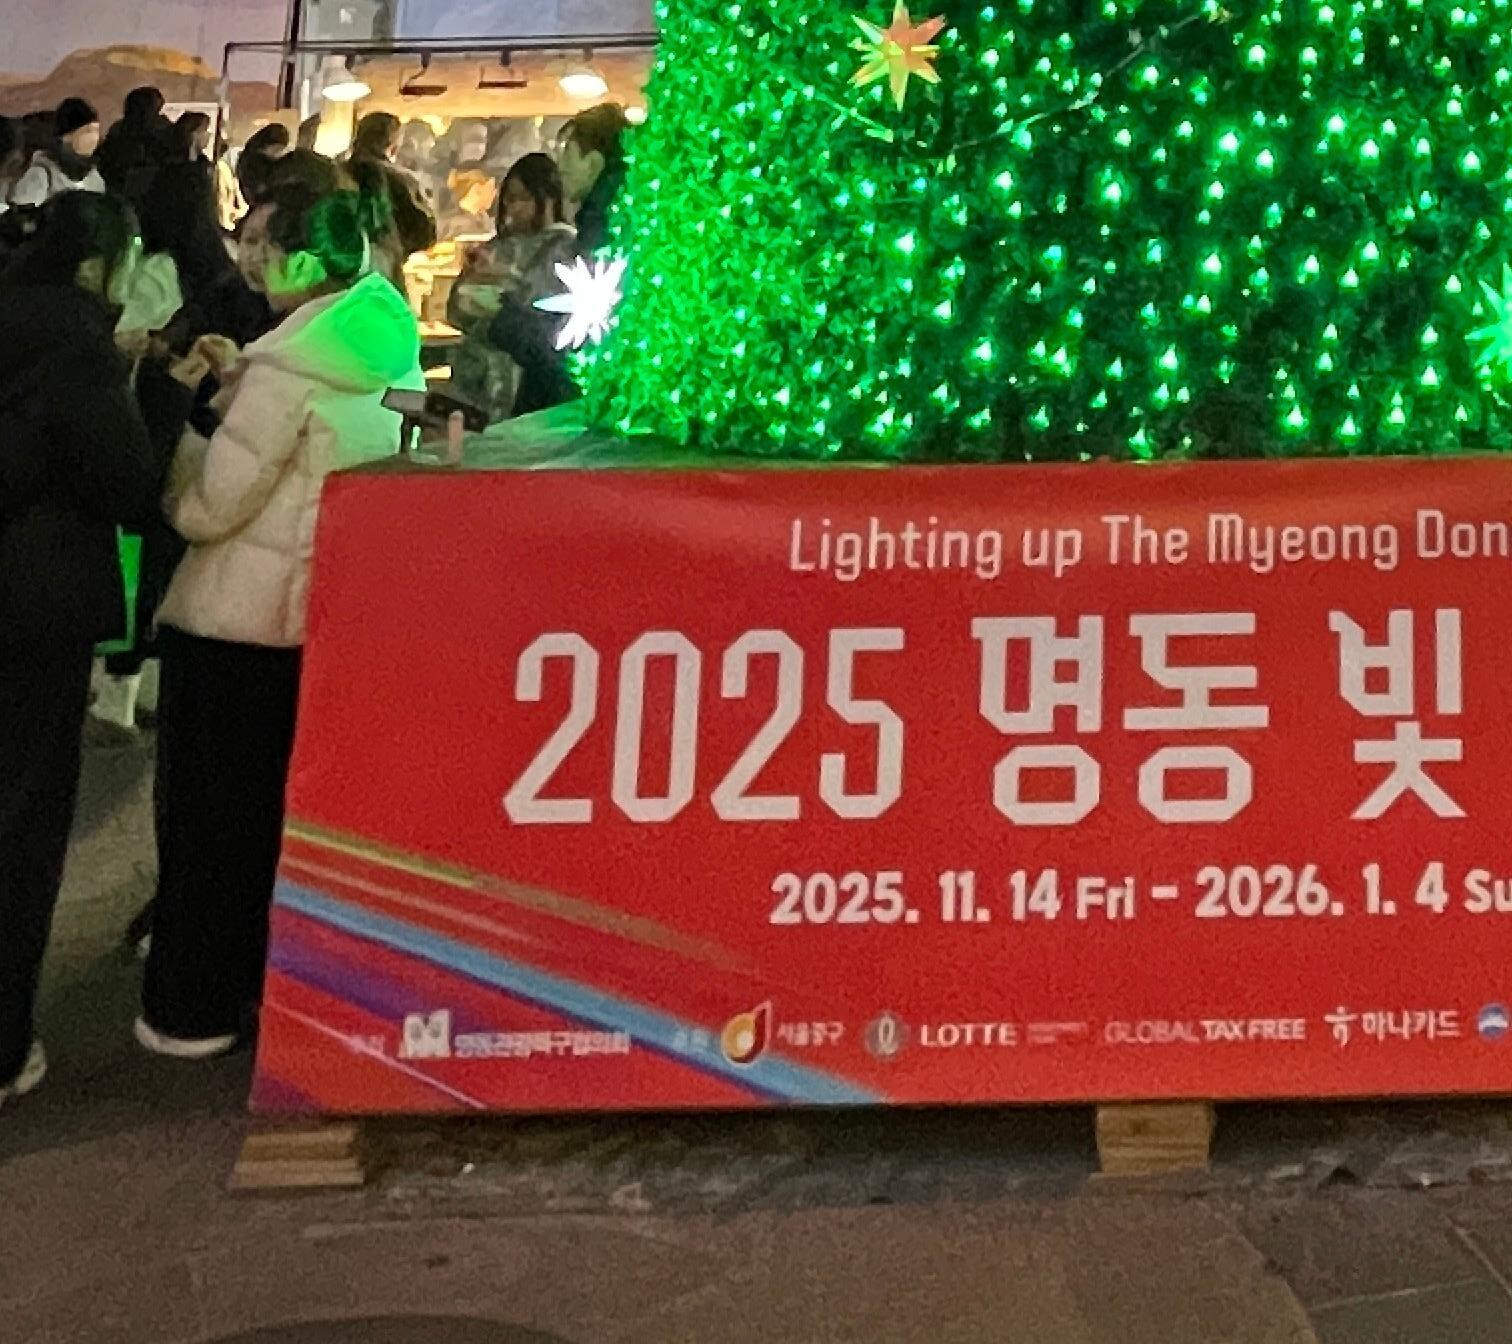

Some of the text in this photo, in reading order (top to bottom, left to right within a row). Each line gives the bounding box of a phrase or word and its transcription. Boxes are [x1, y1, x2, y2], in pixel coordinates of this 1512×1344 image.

[789, 515, 1003, 582] Lighting
[1022, 528, 1083, 578] up
[1101, 513, 1189, 566] The
[1207, 512, 1399, 574] Myeong
[503, 628, 907, 826] 2025
[970, 611, 1270, 826] 명동
[1328, 608, 1467, 820] 빛
[768, 870, 920, 925] 2025.
[938, 869, 992, 923] 11.
[1009, 868, 1062, 921] 14
[1075, 875, 1137, 921] Fri
[1194, 863, 1345, 918] 2026.
[1361, 861, 1398, 915] 1.
[1414, 861, 1450, 913] 4
[919, 1021, 1018, 1049] LOTTE
[1200, 1017, 1245, 1042] TAX
[1246, 1017, 1306, 1041] FREE
[1361, 1008, 1463, 1042] 하나카드
